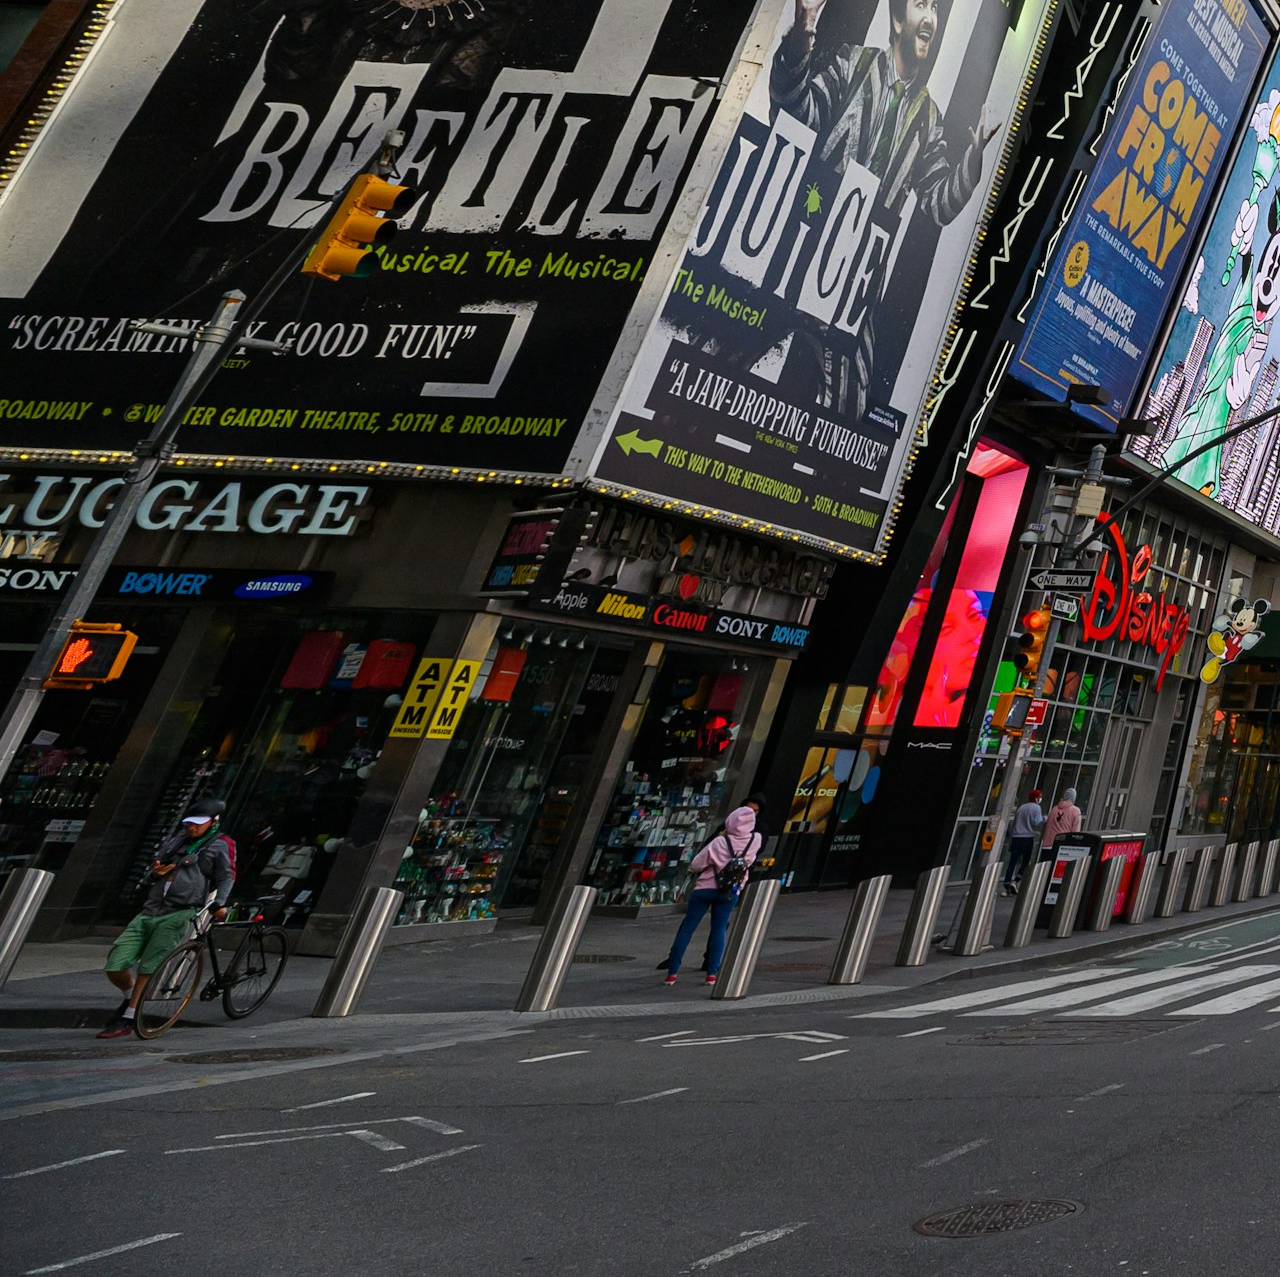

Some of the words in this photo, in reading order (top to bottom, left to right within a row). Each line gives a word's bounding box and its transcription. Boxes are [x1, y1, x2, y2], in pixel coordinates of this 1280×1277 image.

[1211, 8, 1244, 69] MUSICAL
[1160, 38, 1182, 72] COME
[1182, 65, 1219, 117] TOGETHER
[1216, 112, 1229, 129] AT
[1143, 60, 1222, 178] COME
[1091, 166, 1188, 271] AWAY
[1085, 213, 1099, 233] THE
[1096, 224, 1136, 264] REMARKABLE
[1134, 255, 1151, 279] TRUE
[1147, 268, 1166, 291] STORY
[673, 267, 704, 303] The
[705, 284, 768, 331] Musical.
[144, 404, 217, 426] WTER
[220, 407, 299, 429] GARDEN
[300, 410, 381, 434] THEATRE,
[387, 412, 436, 433] 50TH
[440, 415, 454, 434] &
[459, 415, 567, 438] BROADWAY
[686, 368, 809, 442] JAW-DROPPING
[808, 417, 888, 472] FUNHOUSE!”
[664, 445, 686, 468] THIS
[688, 452, 711, 476] WAY
[710, 459, 726, 480] TO
[724, 464, 743, 486] THE
[741, 469, 802, 505] NETHERWORLD
[811, 494, 831, 514] 50TH
[831, 503, 839, 517] &
[838, 504, 880, 529] BROADWAY
[0, 569, 77, 591] SON
[119, 572, 207, 595] BOWER
[246, 581, 302, 593] SAMSUNG
[1037, 575, 1057, 585] ONE
[1066, 576, 1087, 585] WAY
[553, 589, 588, 610] Apple
[596, 593, 645, 621] Nikon
[653, 603, 709, 633] Canon
[715, 616, 769, 641] SONY
[771, 626, 809, 647] BOWER
[400, 663, 441, 725] ATM
[434, 665, 472, 727] ATM
